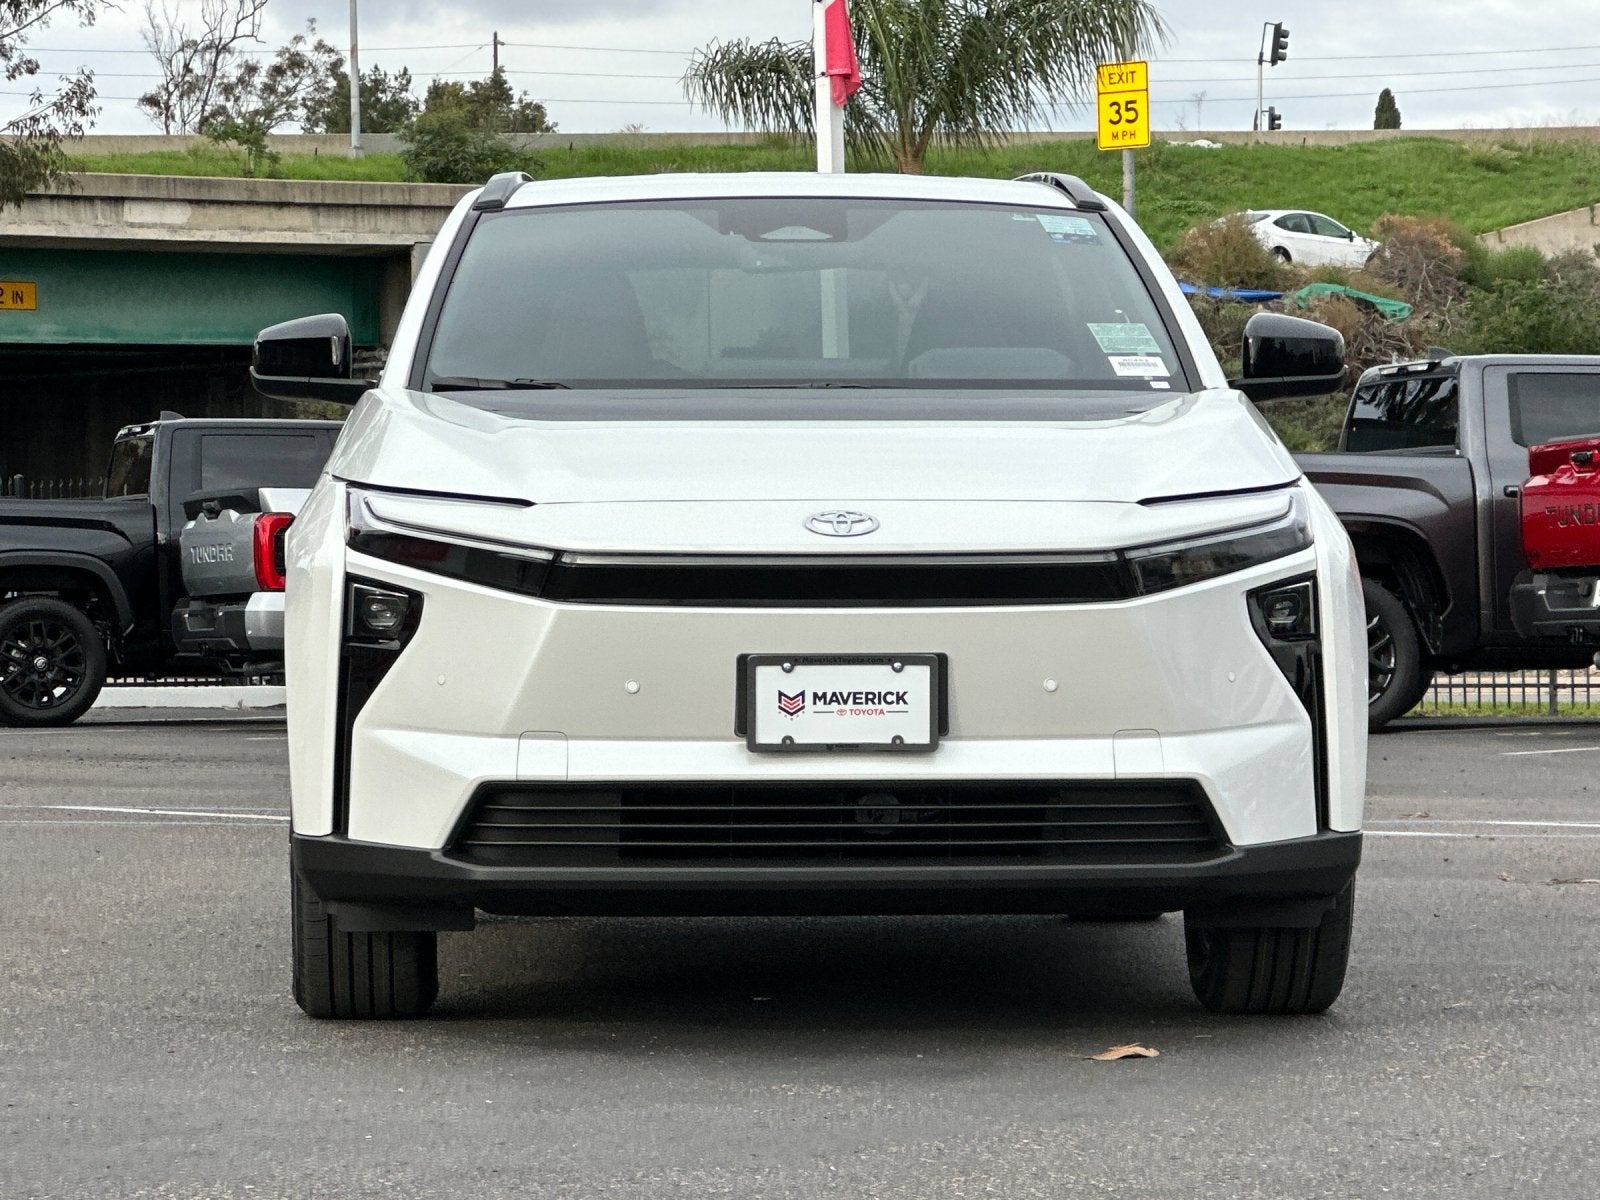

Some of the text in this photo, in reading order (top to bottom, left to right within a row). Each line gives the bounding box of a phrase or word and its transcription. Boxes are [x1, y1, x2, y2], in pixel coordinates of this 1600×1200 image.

[1108, 71, 1136, 85] EXIT
[1108, 100, 1139, 125] 35
[1111, 130, 1136, 141] MPH
[12, 289, 24, 305] IN
[1545, 502, 1600, 528] TUND
[190, 542, 234, 564] TUNDRA
[812, 691, 909, 706] MAVERICK
[849, 708, 886, 716] TOYOTA
